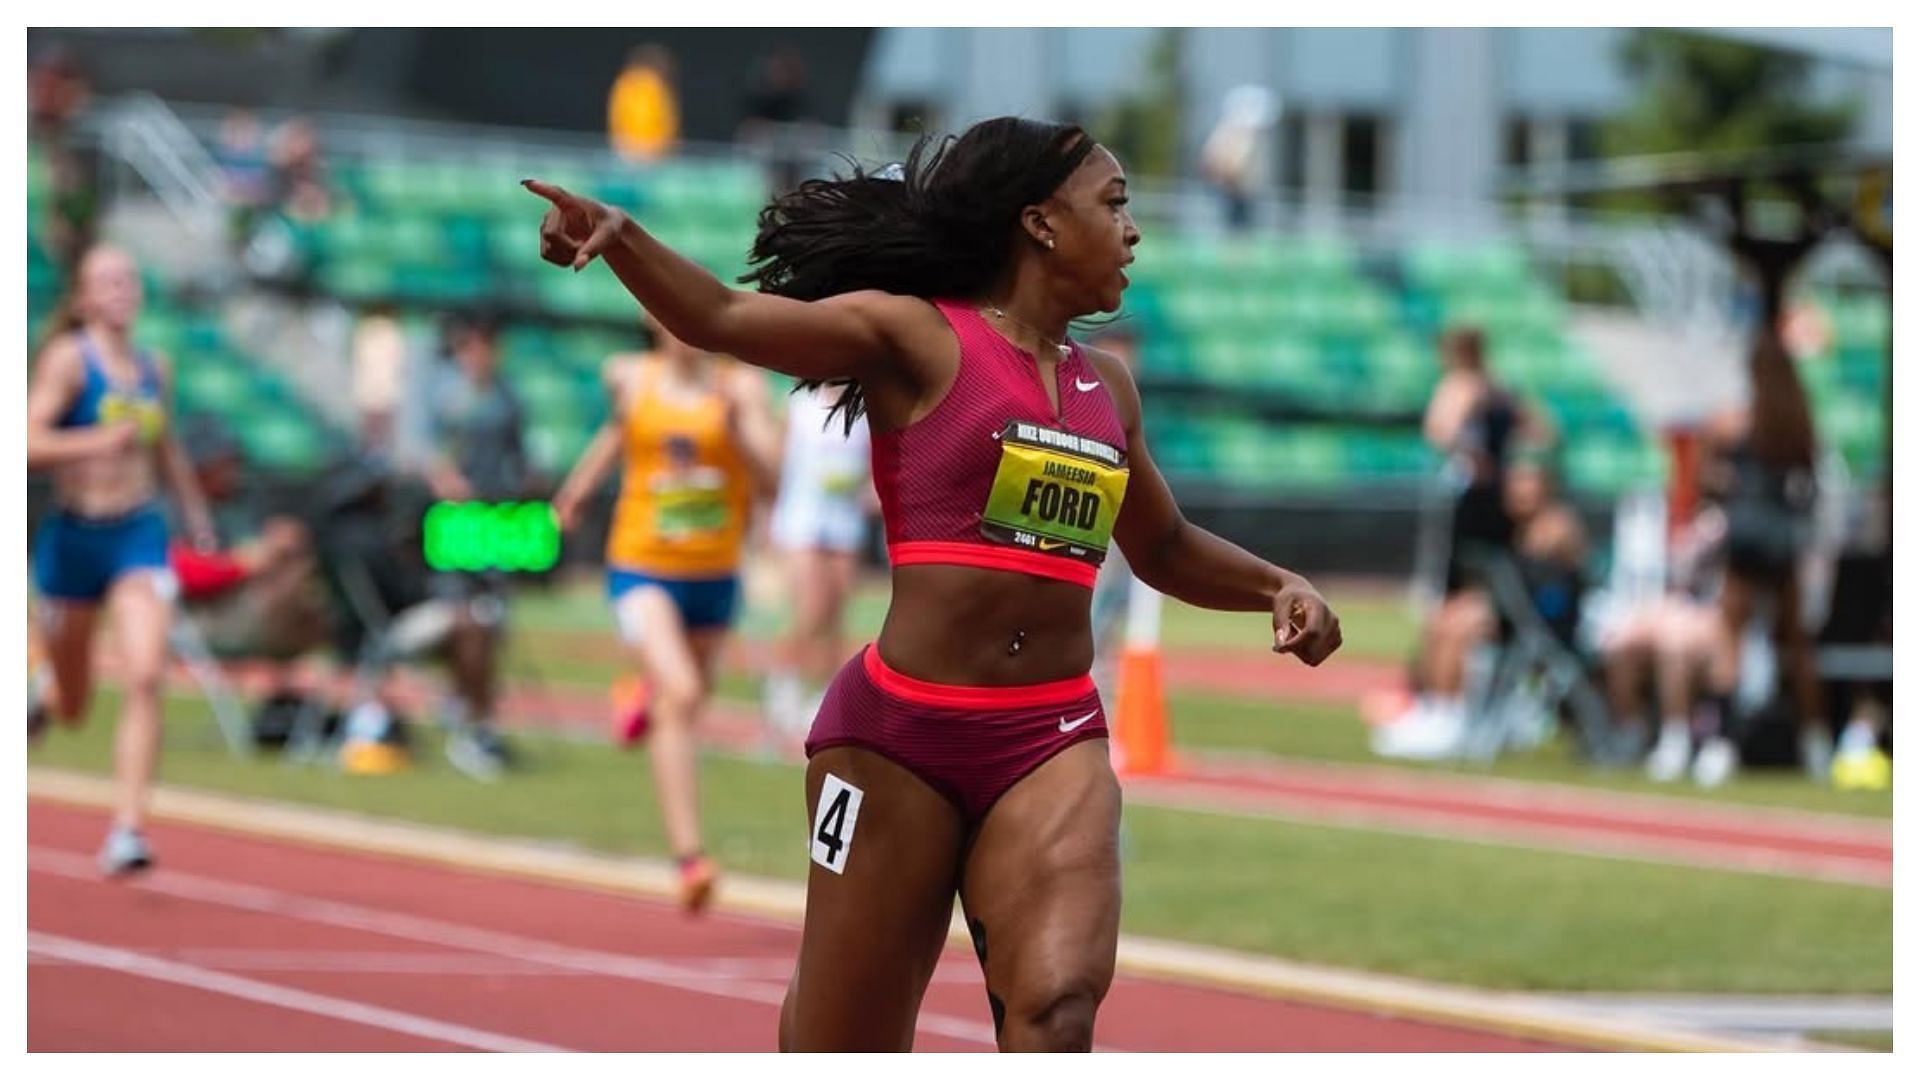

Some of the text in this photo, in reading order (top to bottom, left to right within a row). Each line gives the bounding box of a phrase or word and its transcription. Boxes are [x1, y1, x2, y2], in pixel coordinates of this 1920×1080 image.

[1043, 462, 1097, 485] JAMEESIA
[1021, 479, 1101, 531] FORD
[818, 788, 851, 864] 4
